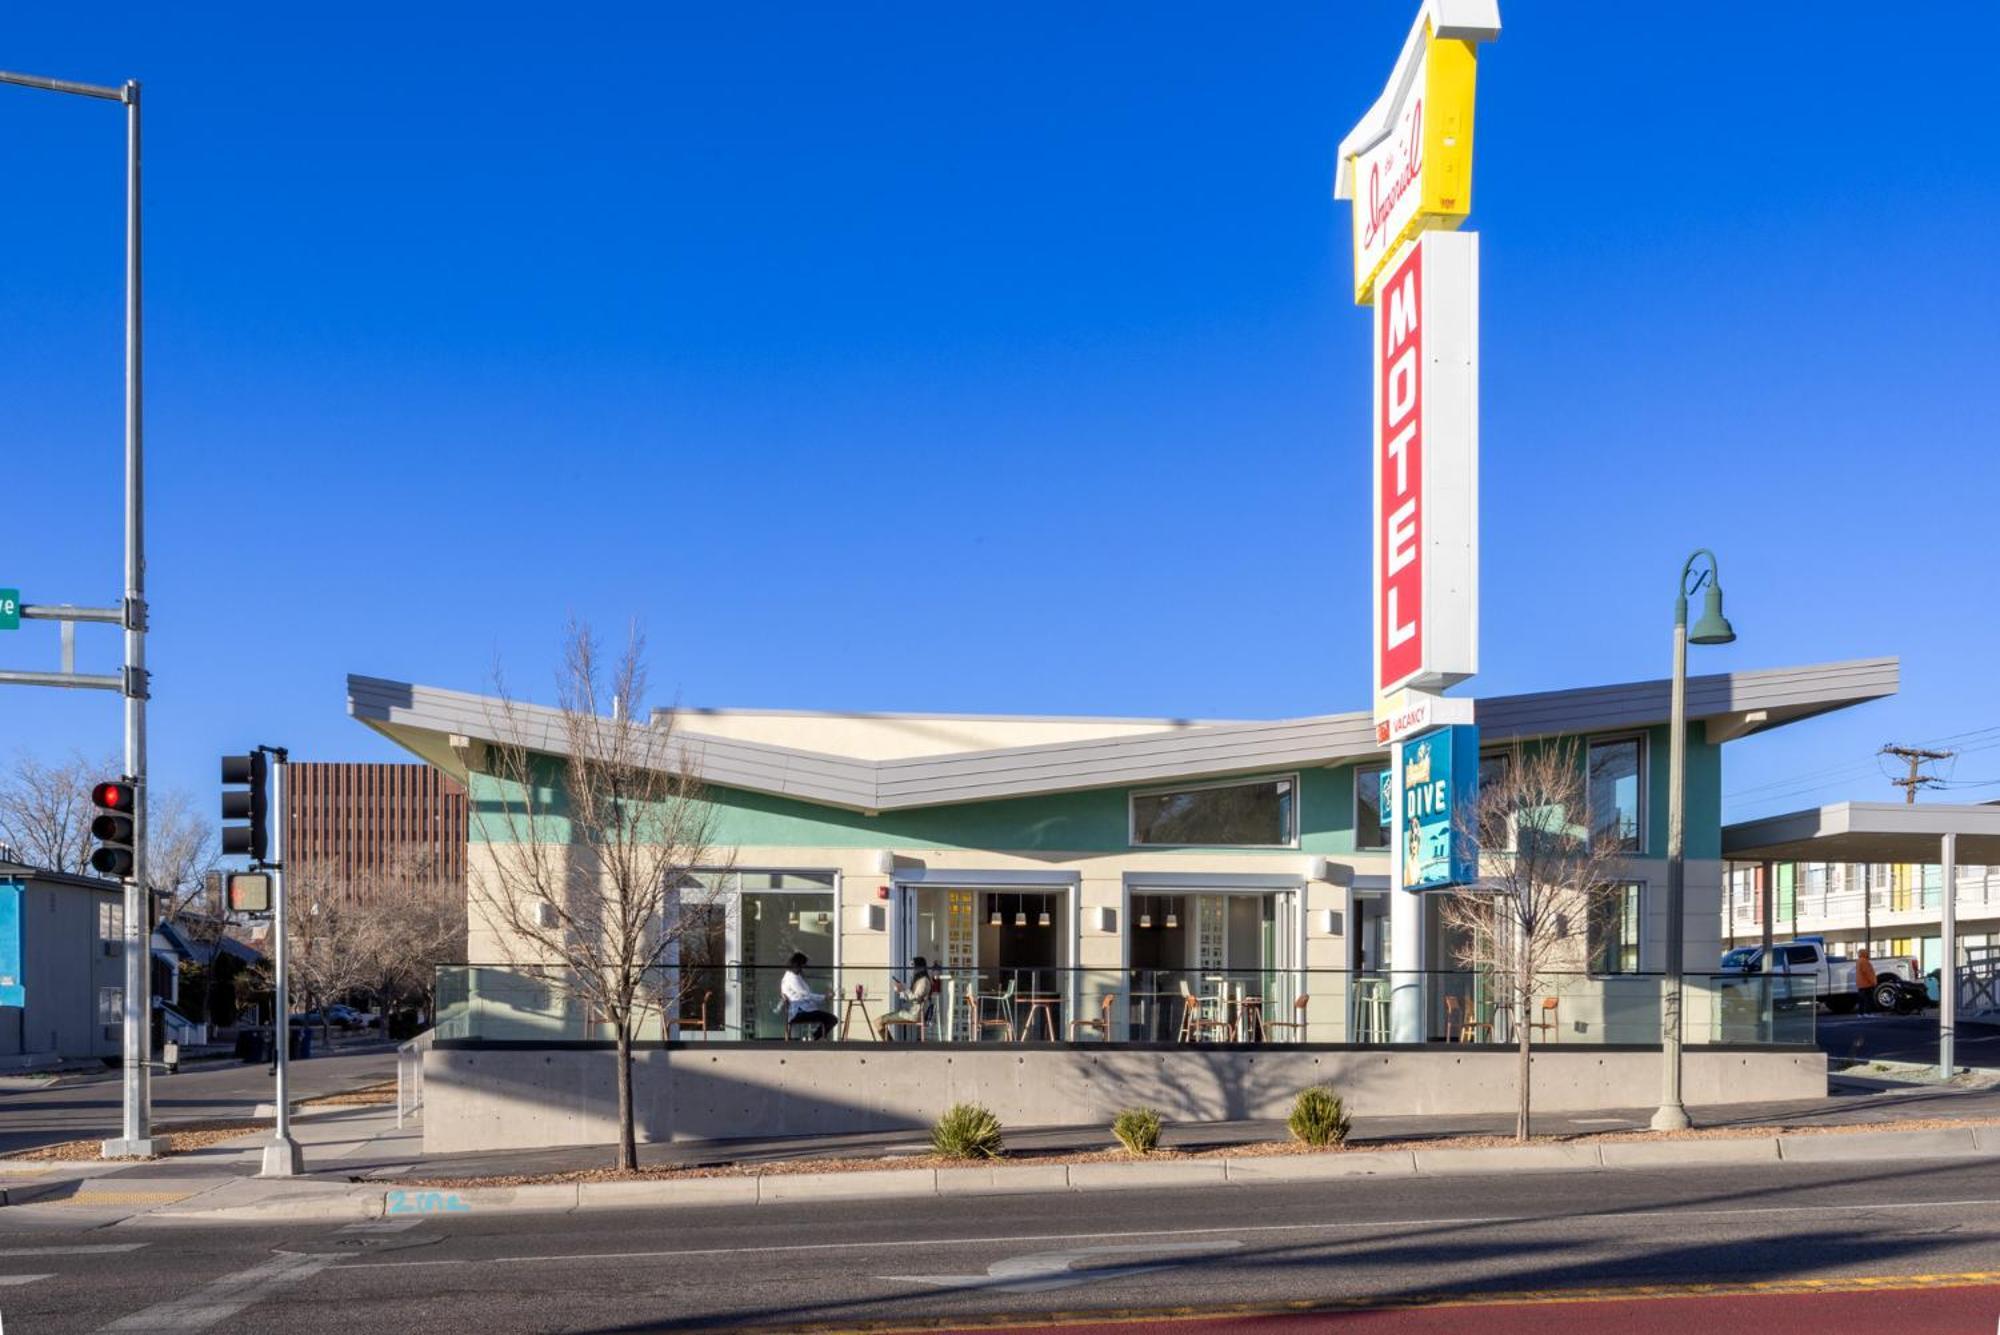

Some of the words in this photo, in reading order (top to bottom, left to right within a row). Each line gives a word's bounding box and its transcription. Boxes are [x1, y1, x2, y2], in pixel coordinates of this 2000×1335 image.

[1388, 269, 1418, 651] MOTEL
[1394, 707, 1425, 732] VACANCY
[1407, 779, 1446, 819] DIVE
